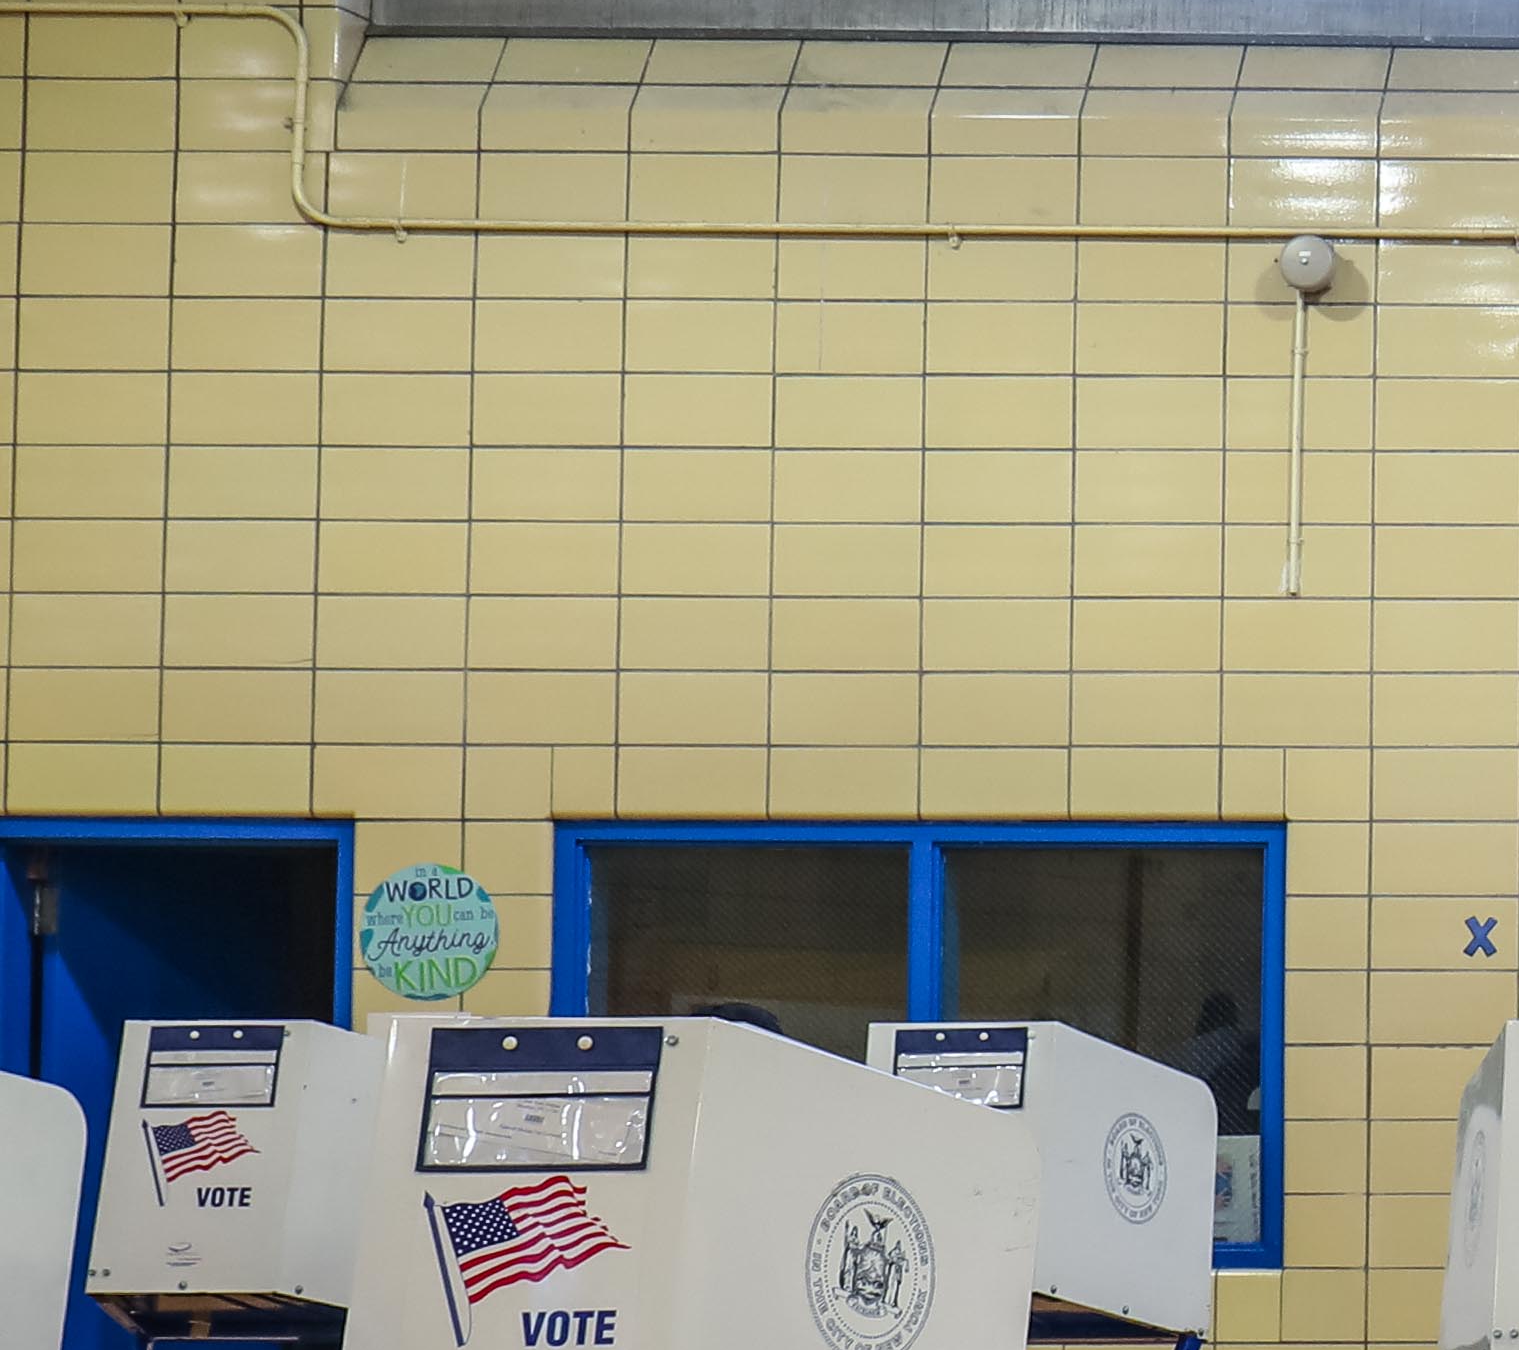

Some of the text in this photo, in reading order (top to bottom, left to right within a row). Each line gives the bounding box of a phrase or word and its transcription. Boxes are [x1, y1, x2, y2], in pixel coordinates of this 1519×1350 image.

[385, 877, 474, 903] WORLD
[366, 912, 403, 926] where
[402, 903, 453, 928] YOU
[453, 909, 475, 921] can
[394, 956, 478, 993] KIND
[196, 1186, 251, 1208] VOTE
[820, 1186, 859, 1232] BOARD
[883, 1186, 929, 1266] ELECTIONS
[521, 1309, 617, 1347] VOTE
[825, 1318, 854, 1350] CITY
